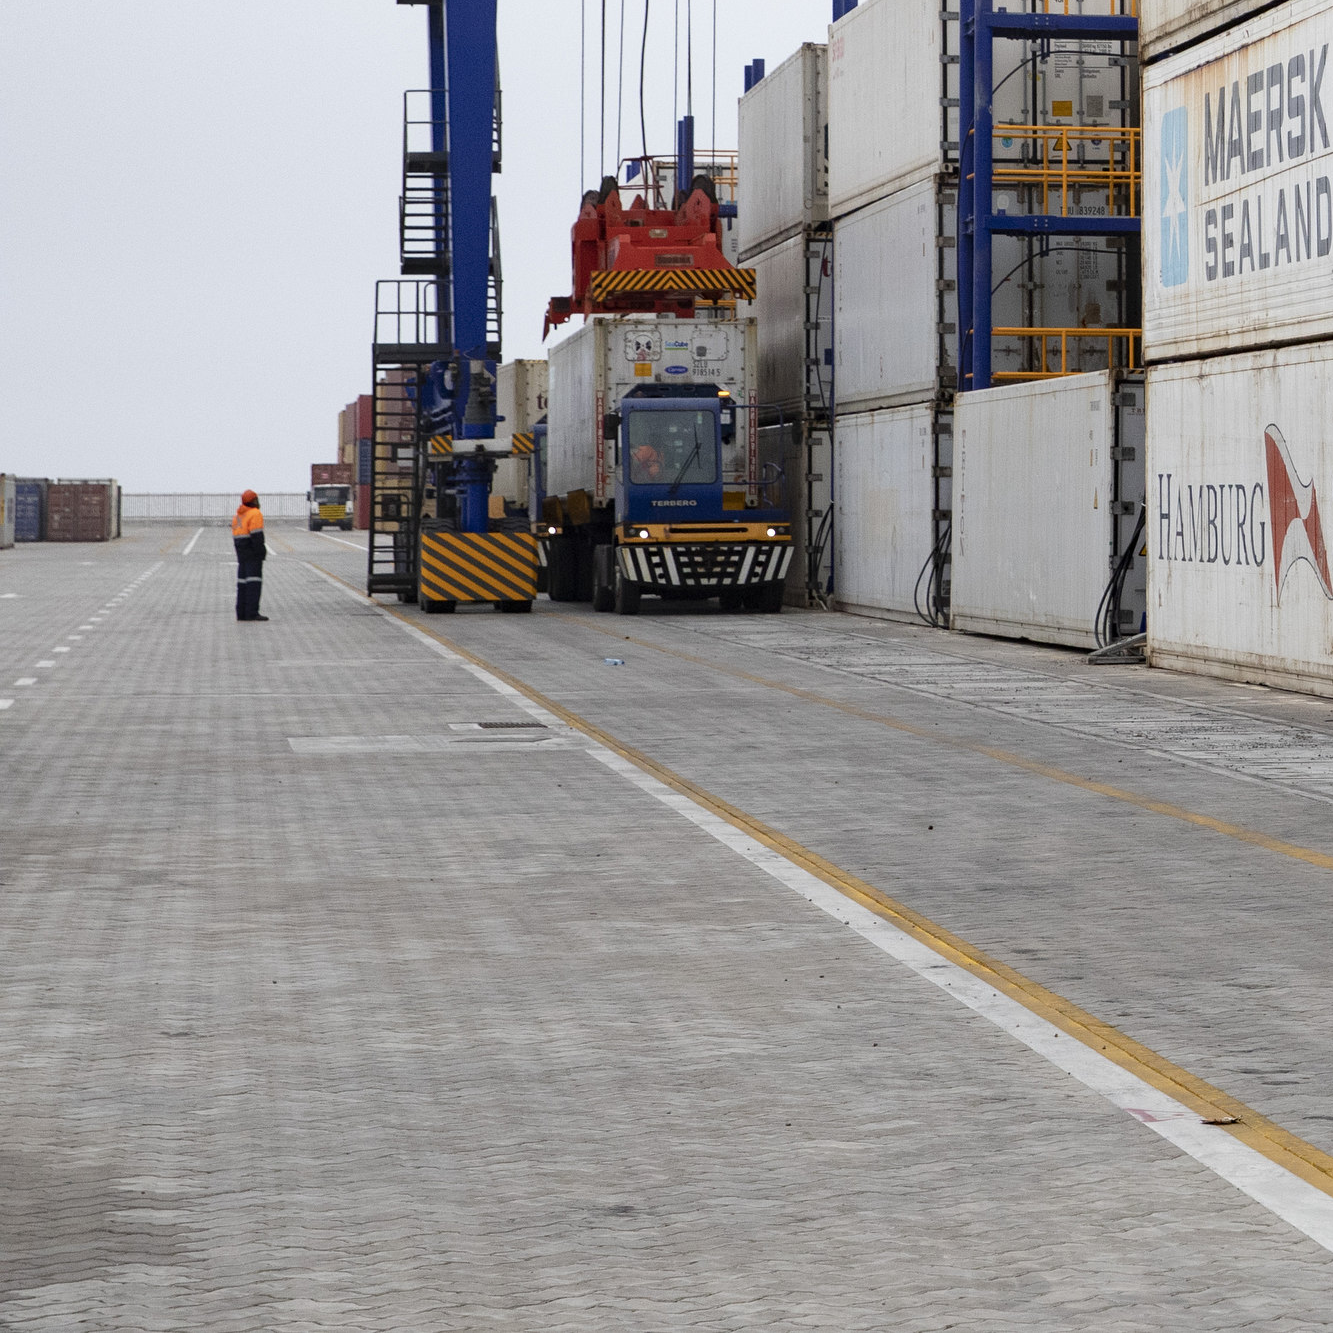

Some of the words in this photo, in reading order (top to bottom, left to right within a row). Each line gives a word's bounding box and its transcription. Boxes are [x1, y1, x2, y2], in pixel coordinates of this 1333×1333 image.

[1203, 42, 1331, 188] MAERSK
[1079, 205, 1106, 215] 839248
[1204, 175, 1333, 282] SEALAND
[651, 499, 698, 508] TERBERG
[1157, 472, 1267, 569] HAMBURG
